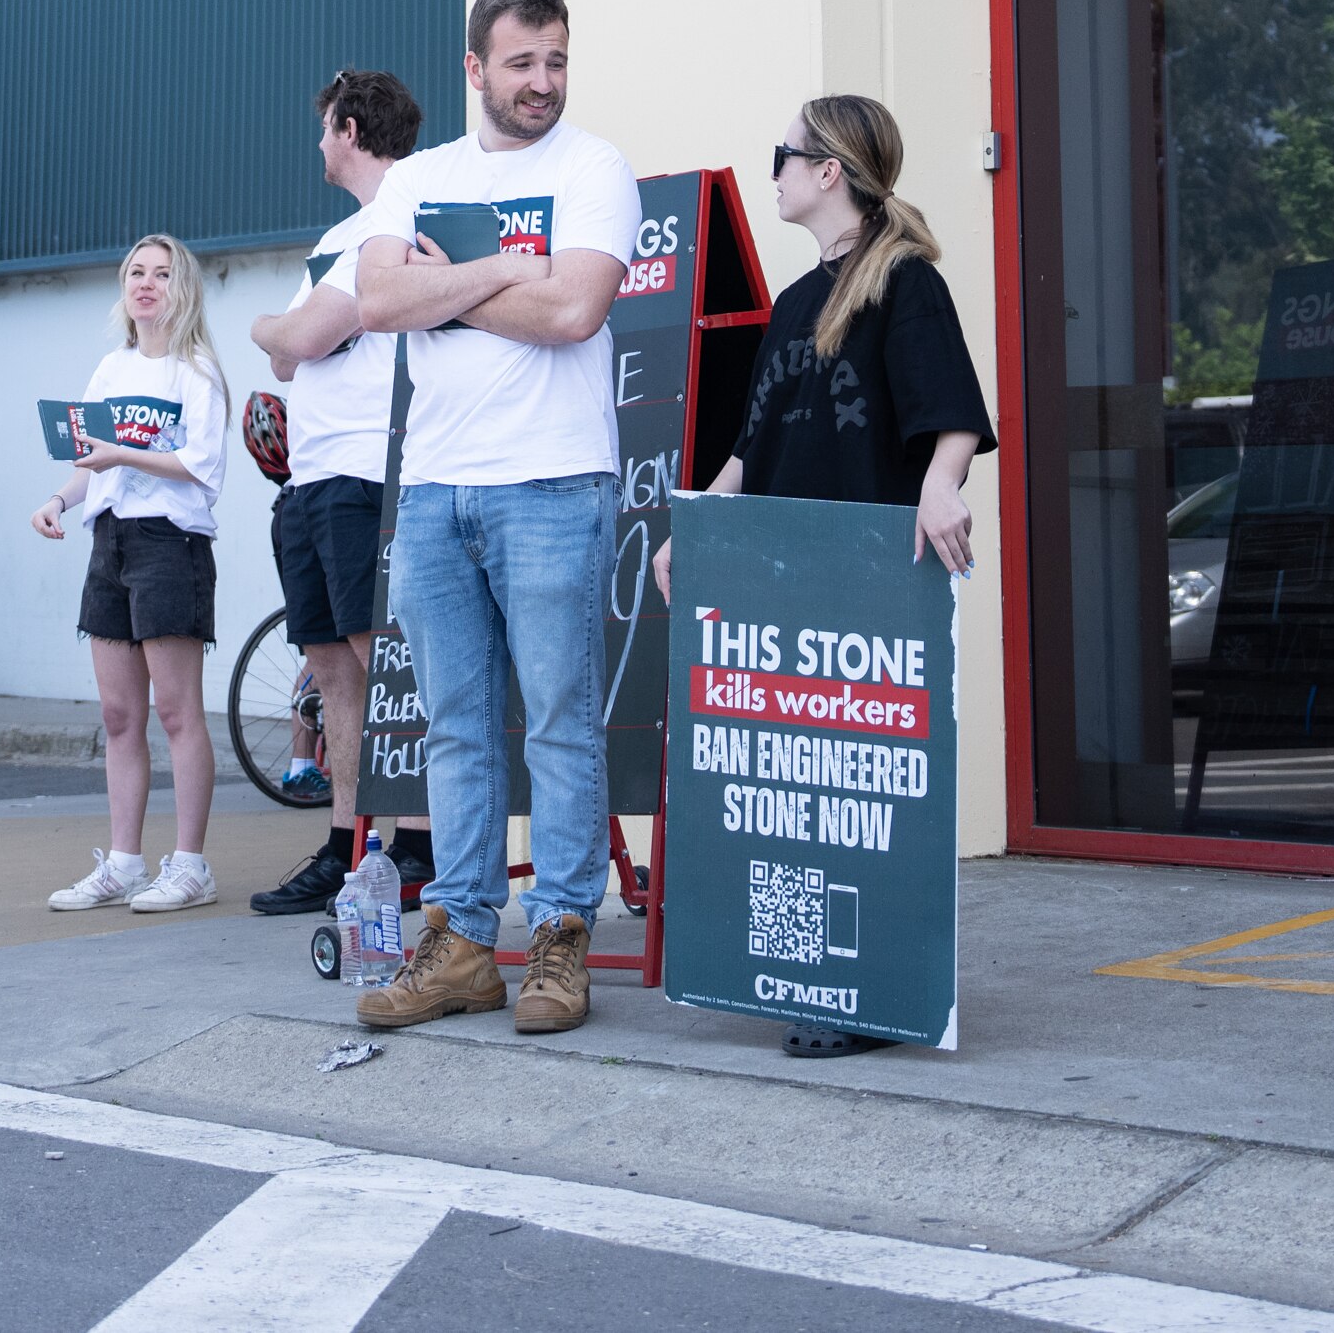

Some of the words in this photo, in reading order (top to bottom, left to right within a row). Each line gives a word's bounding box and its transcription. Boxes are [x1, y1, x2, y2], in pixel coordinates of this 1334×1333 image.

[696, 606, 781, 672] THIS
[796, 628, 925, 687] STONE
[705, 670, 766, 712] kills
[775, 684, 916, 729] workers
[693, 723, 750, 776] BAN
[757, 731, 928, 798] ENGINEERED
[723, 783, 812, 841] STONE
[818, 795, 894, 852] NOW
[381, 903, 403, 955] pump
[755, 974, 858, 1015] CFMEU
